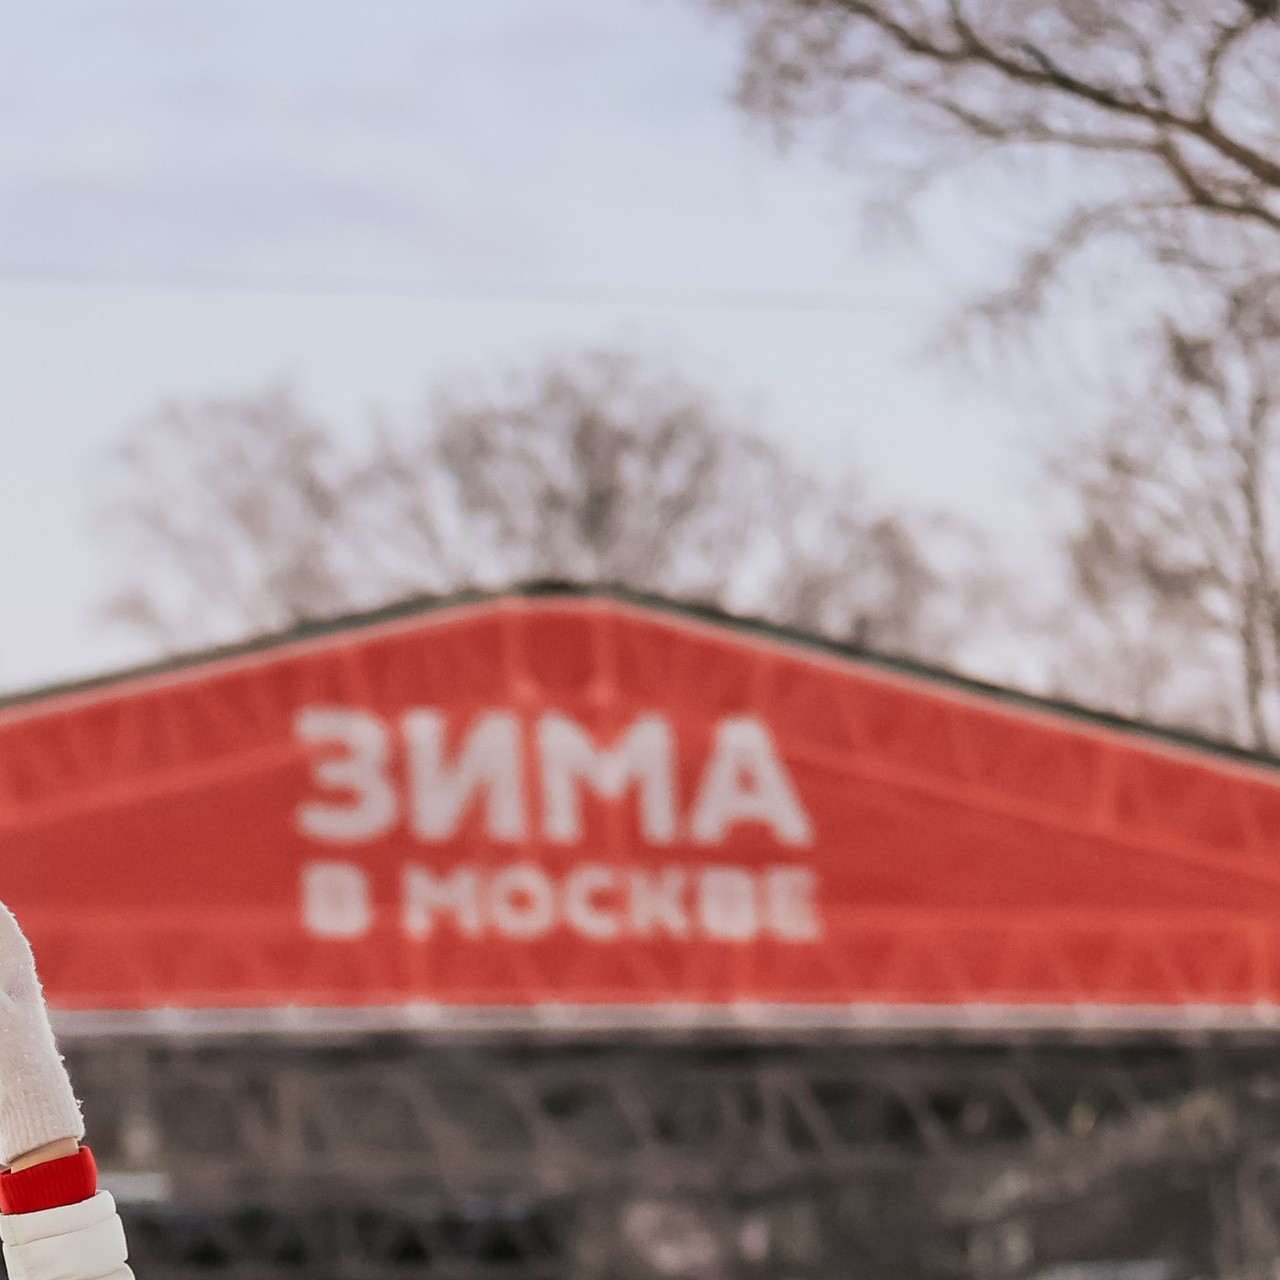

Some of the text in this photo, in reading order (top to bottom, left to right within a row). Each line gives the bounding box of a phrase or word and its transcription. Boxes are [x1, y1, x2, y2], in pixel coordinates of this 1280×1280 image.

[295, 706, 813, 848] ЗИМА
[300, 860, 820, 942] В МОСКВЕ
